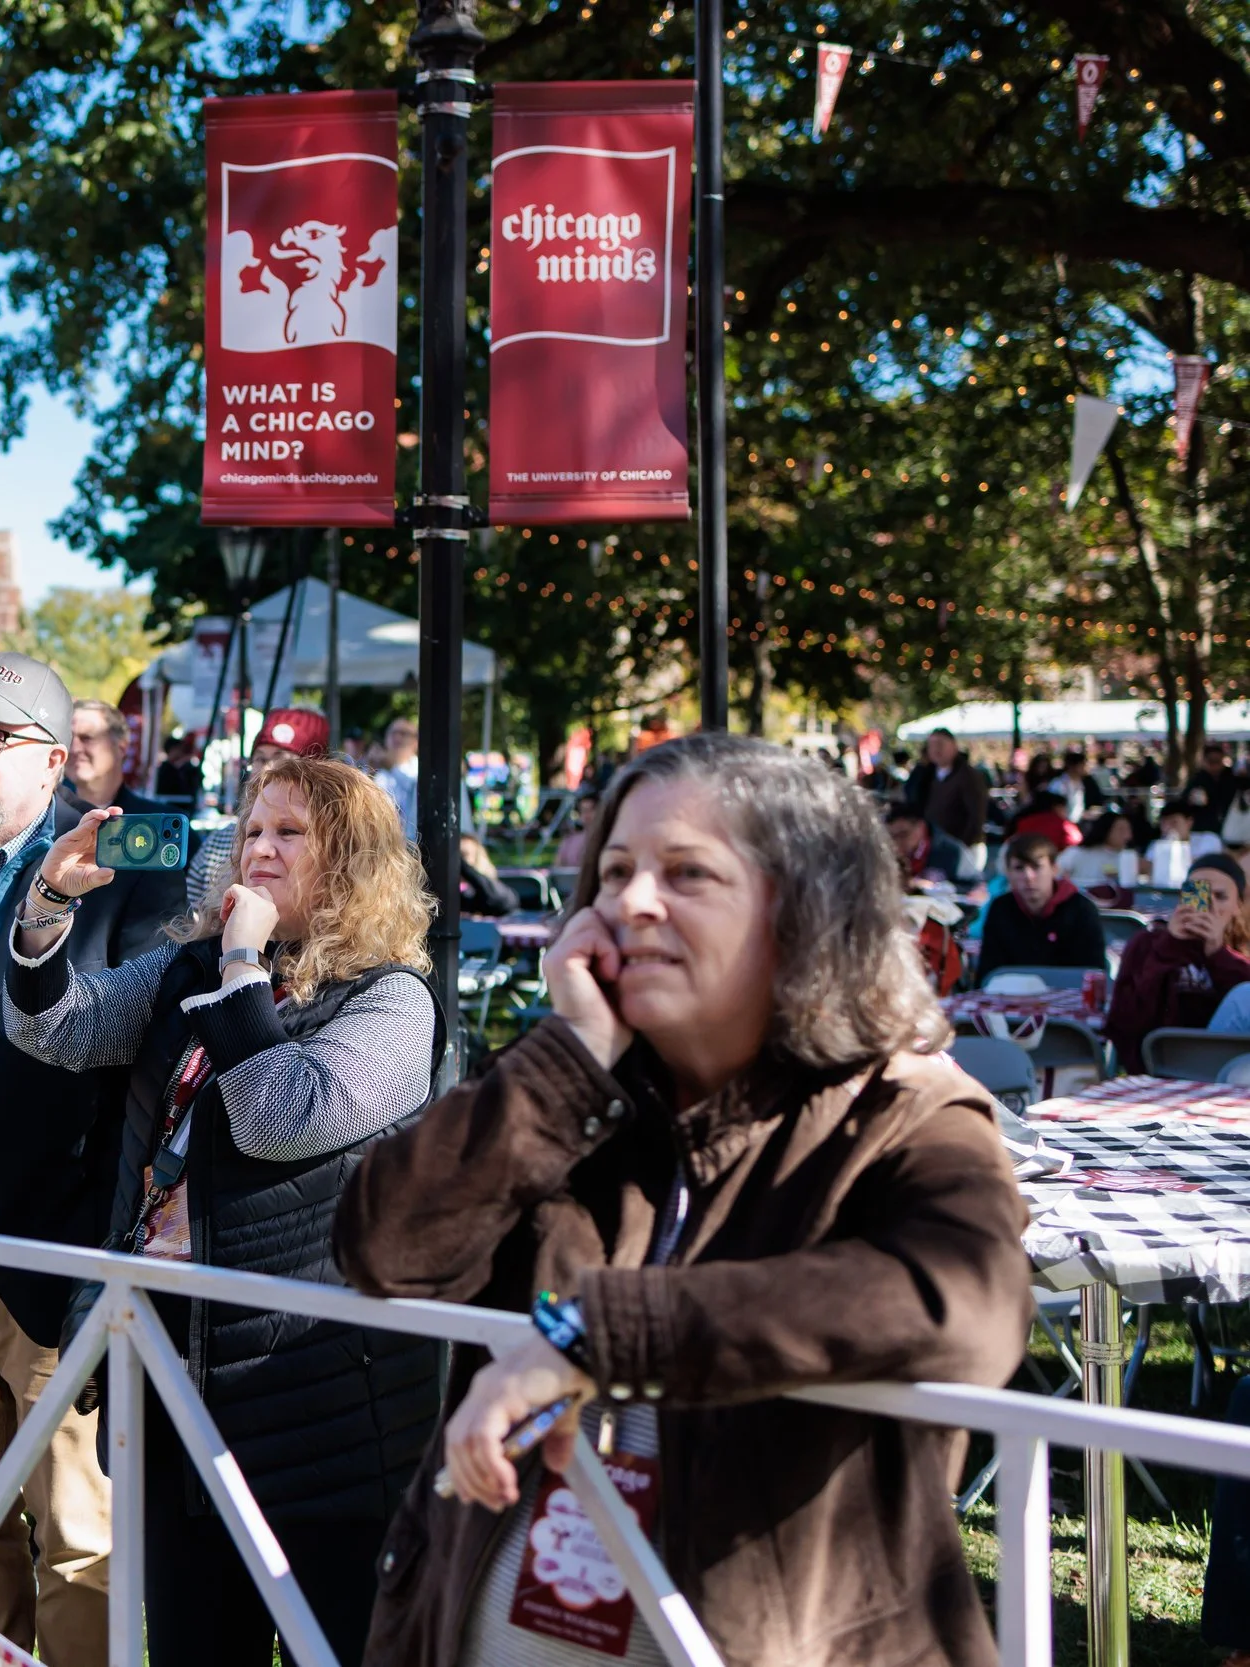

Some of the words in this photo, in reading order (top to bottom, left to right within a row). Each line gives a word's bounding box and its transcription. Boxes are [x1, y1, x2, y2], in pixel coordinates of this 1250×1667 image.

[502, 203, 642, 252] chicago
[536, 245, 657, 283] minds
[221, 383, 303, 405] WHAT
[311, 381, 336, 403] IS
[221, 413, 241, 434] A
[249, 410, 375, 433] CHICAGO
[221, 440, 305, 462] MIND?
[220, 472, 378, 485] chicagominds.uchicago.edu
[506, 472, 529, 483] THE
[531, 471, 598, 483] UNIVERSITY
[600, 470, 617, 482] OF
[619, 469, 672, 481] CHICAGO
[37, 879, 49, 894] 21
[183, 1046, 205, 1084] University
